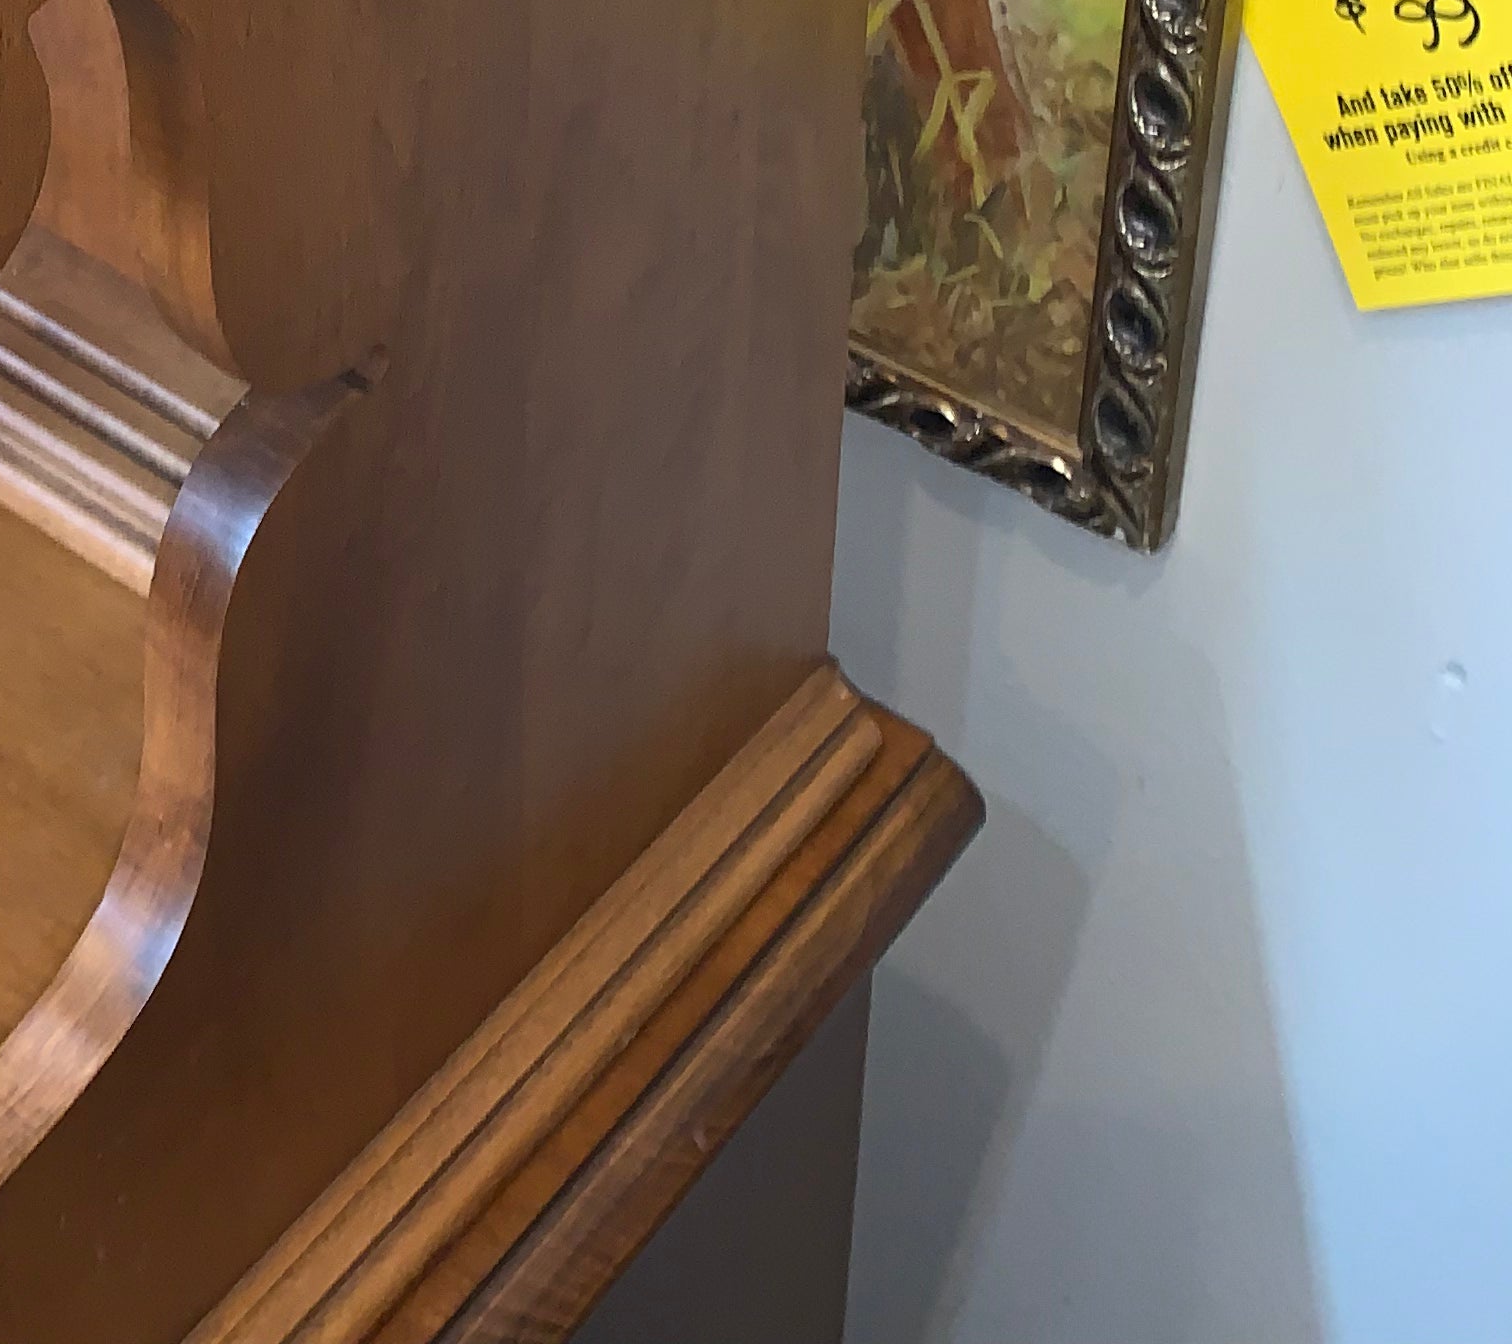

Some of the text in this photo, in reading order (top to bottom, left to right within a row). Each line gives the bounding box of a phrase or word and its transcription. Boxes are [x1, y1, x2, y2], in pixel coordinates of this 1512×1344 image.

[1337, 85, 1376, 117] And
[1380, 81, 1428, 110] take
[1431, 70, 1484, 101] 50%
[1323, 97, 1507, 151] when paying with
[1405, 145, 1446, 165] Using
[1460, 137, 1501, 158] credit
